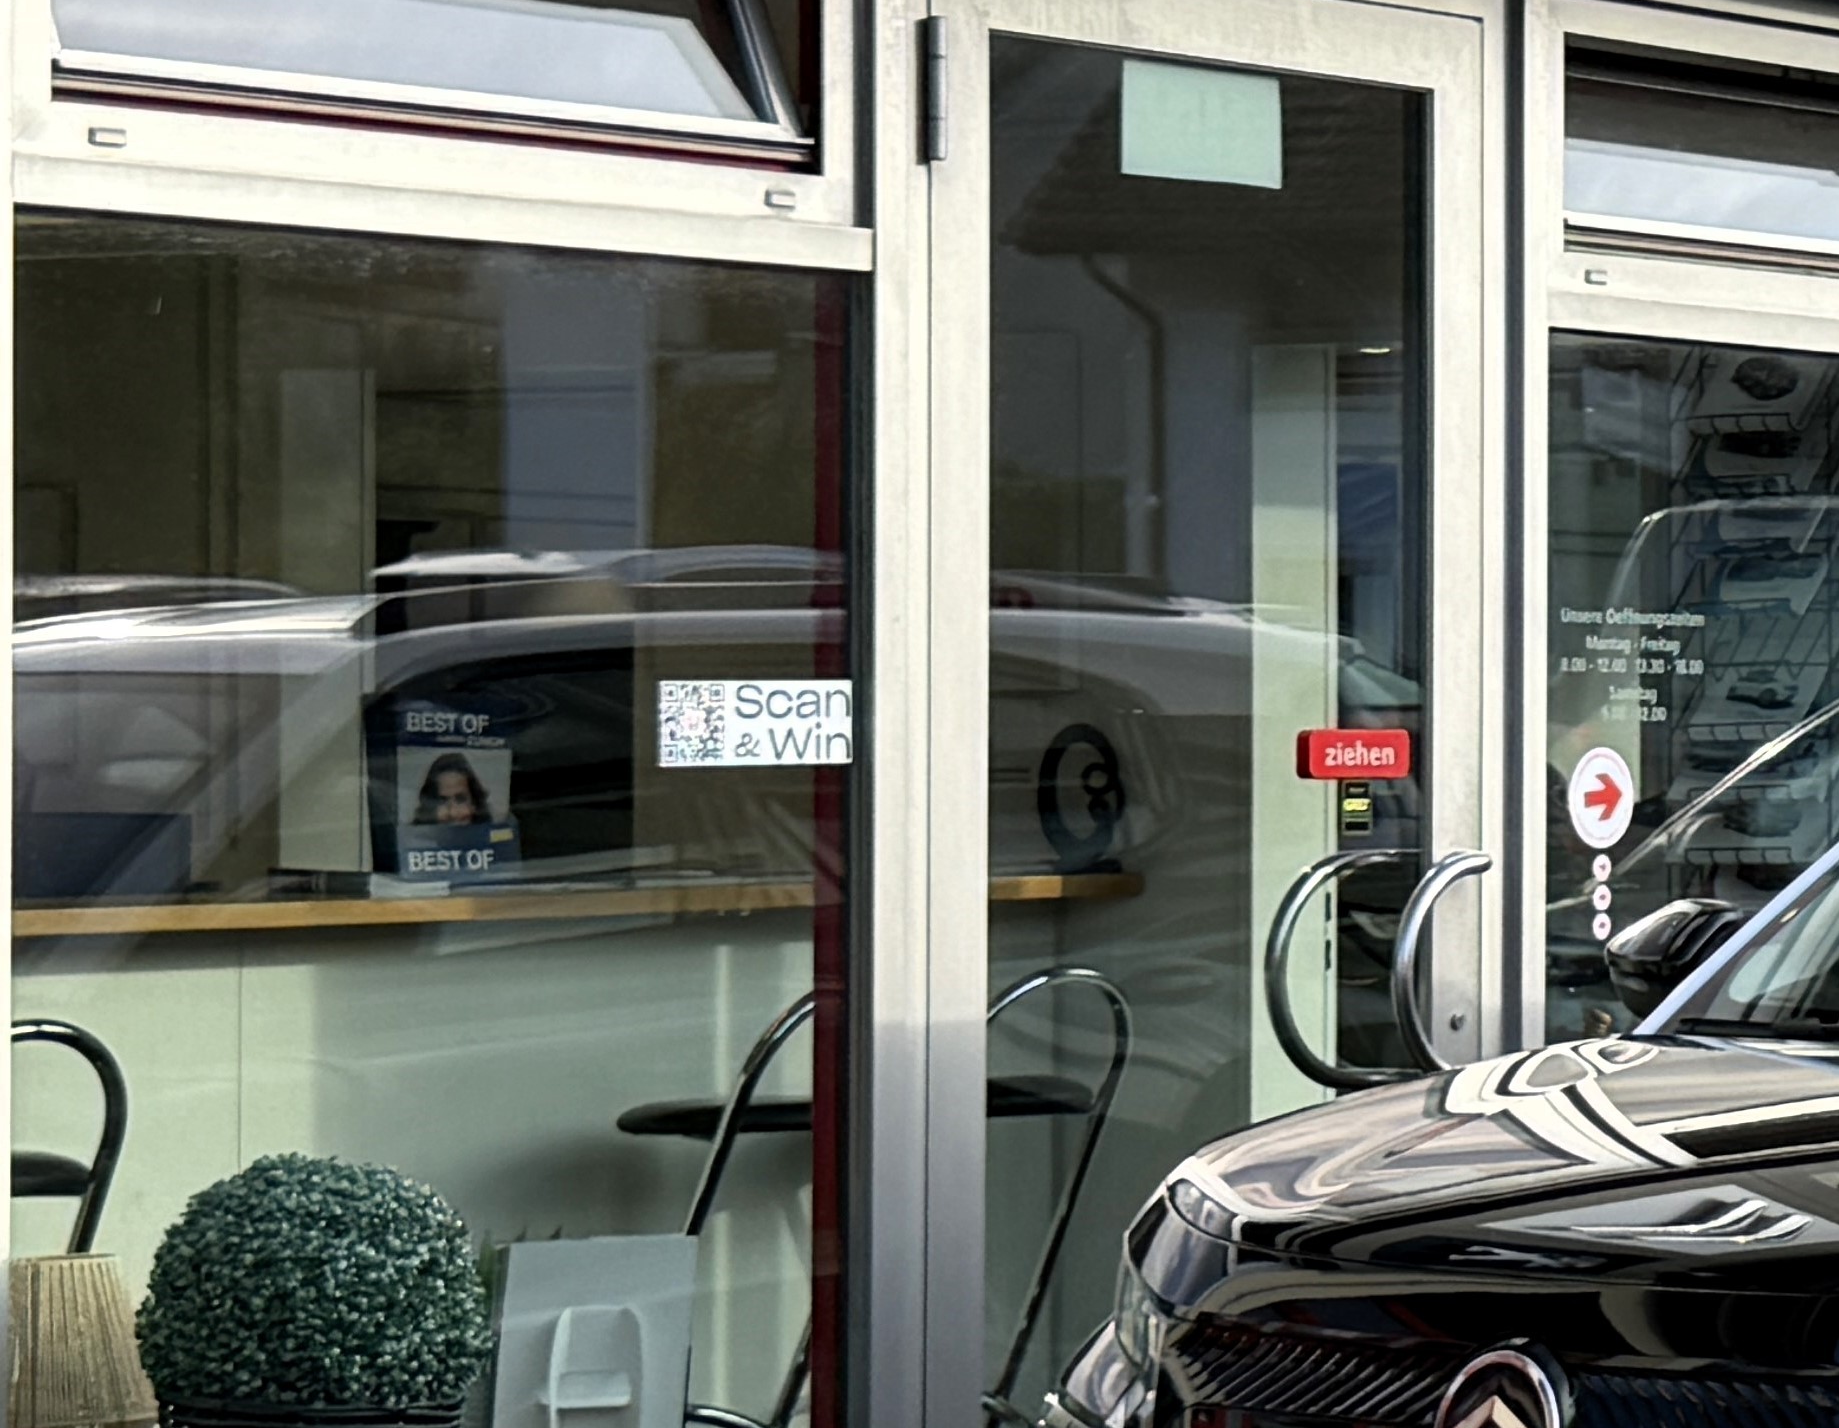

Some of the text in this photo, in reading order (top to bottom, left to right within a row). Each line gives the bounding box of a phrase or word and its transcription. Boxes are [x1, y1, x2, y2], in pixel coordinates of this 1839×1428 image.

[735, 683, 851, 719] Scan
[405, 711, 490, 734] BEST OF
[734, 721, 852, 761] & Win
[1324, 740, 1396, 767] ziehen
[407, 849, 495, 872] BEST OF
